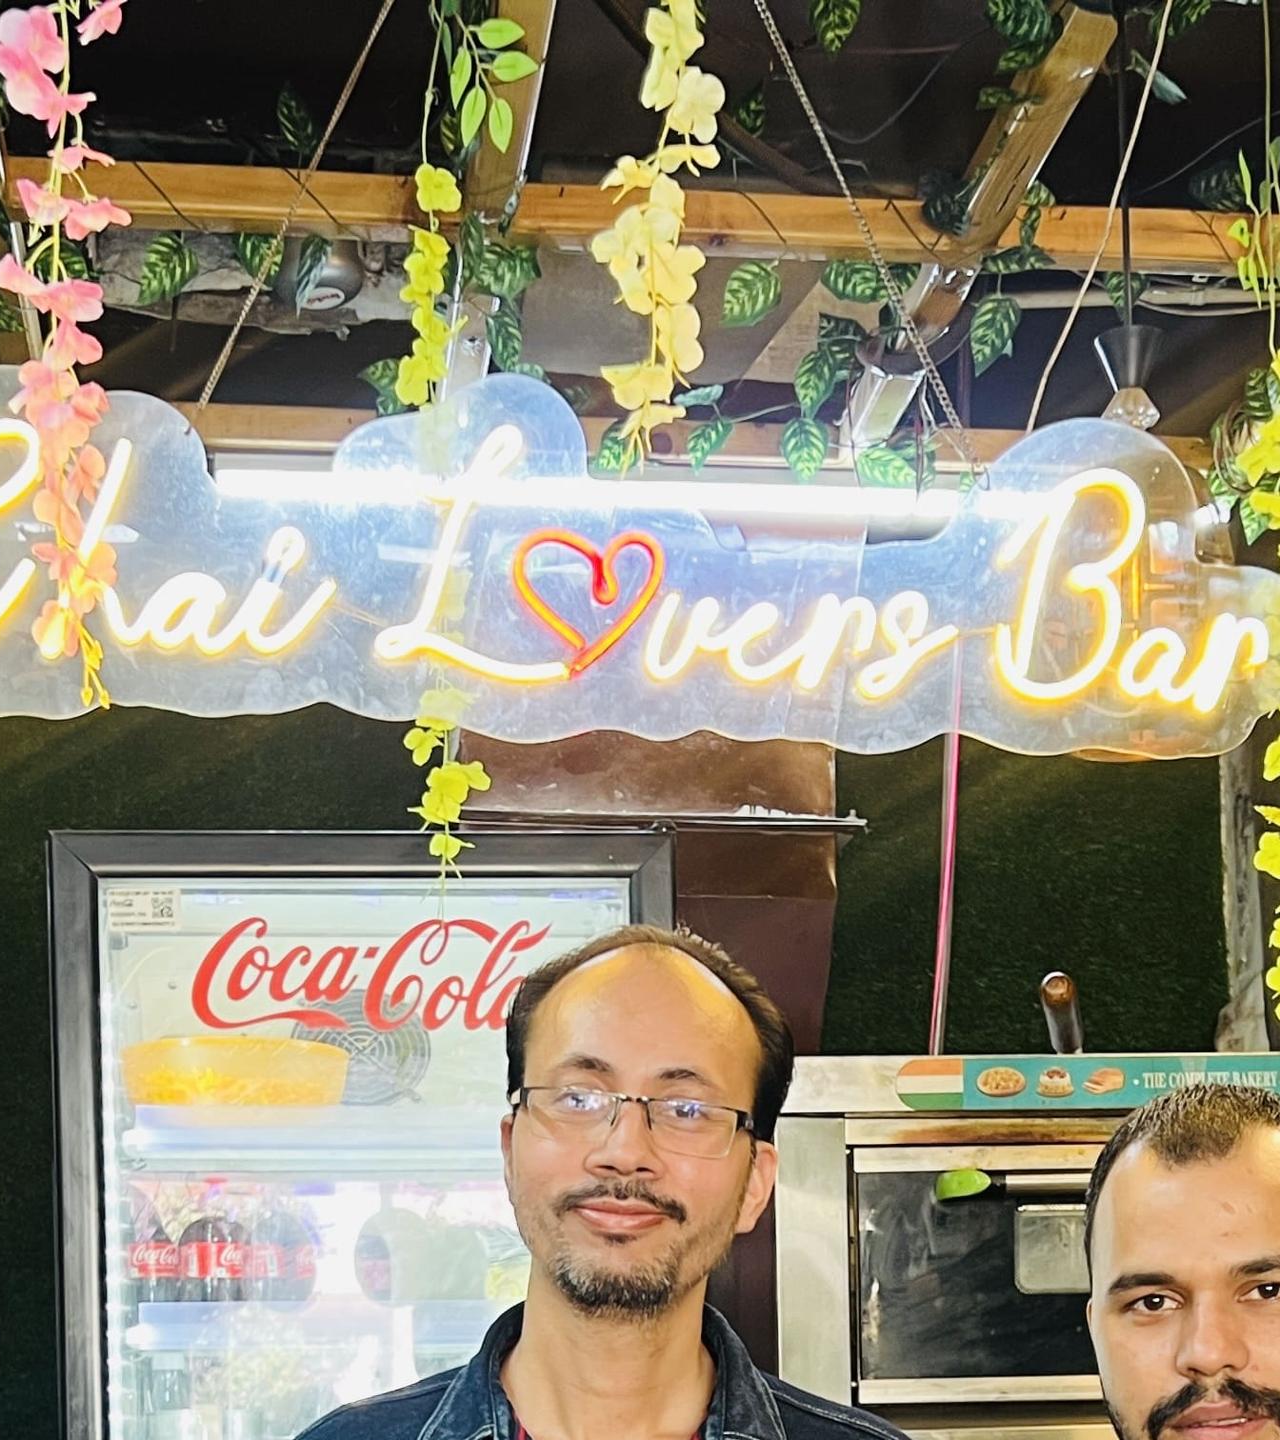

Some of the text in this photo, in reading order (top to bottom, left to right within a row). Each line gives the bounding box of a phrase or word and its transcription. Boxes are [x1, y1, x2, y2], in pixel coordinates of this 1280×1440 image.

[992, 467, 1271, 714] Bar
[1142, 1072, 1167, 1088] THE
[1169, 1070, 1230, 1088] COMPLETE
[1232, 1071, 1277, 1087] BAKERY
